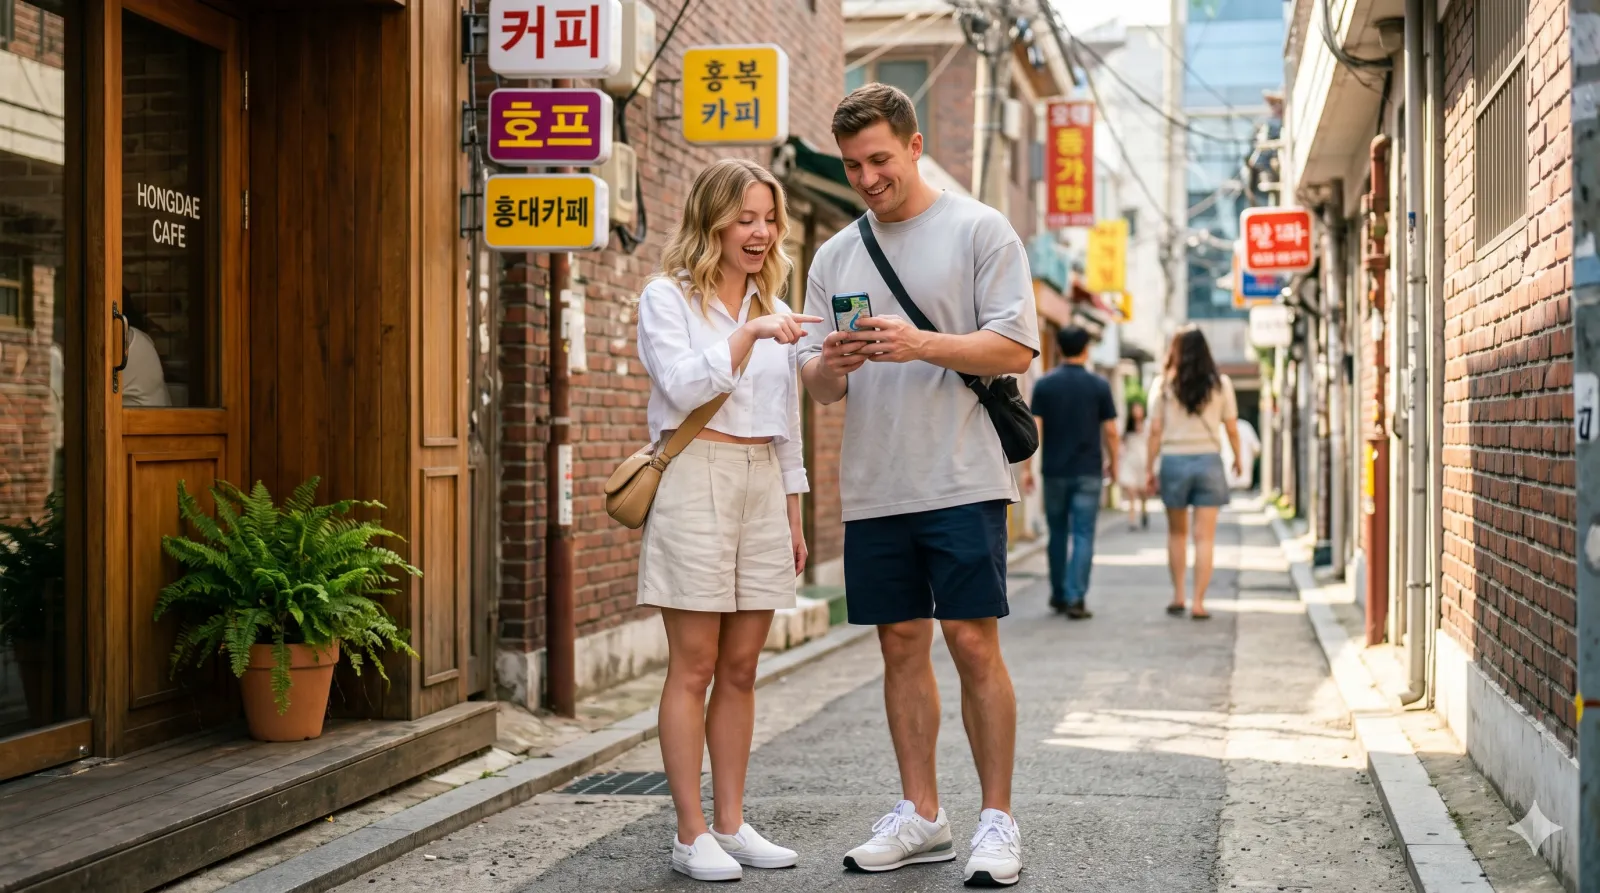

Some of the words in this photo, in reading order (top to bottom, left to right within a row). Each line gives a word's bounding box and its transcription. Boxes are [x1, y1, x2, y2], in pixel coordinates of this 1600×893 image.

[501, 5, 599, 59] 커피
[498, 101, 593, 147] 호프
[701, 97, 760, 129] 카피
[137, 182, 200, 220] HONGDAE
[493, 195, 588, 228] 홍대카페
[152, 219, 186, 248] CAFE
